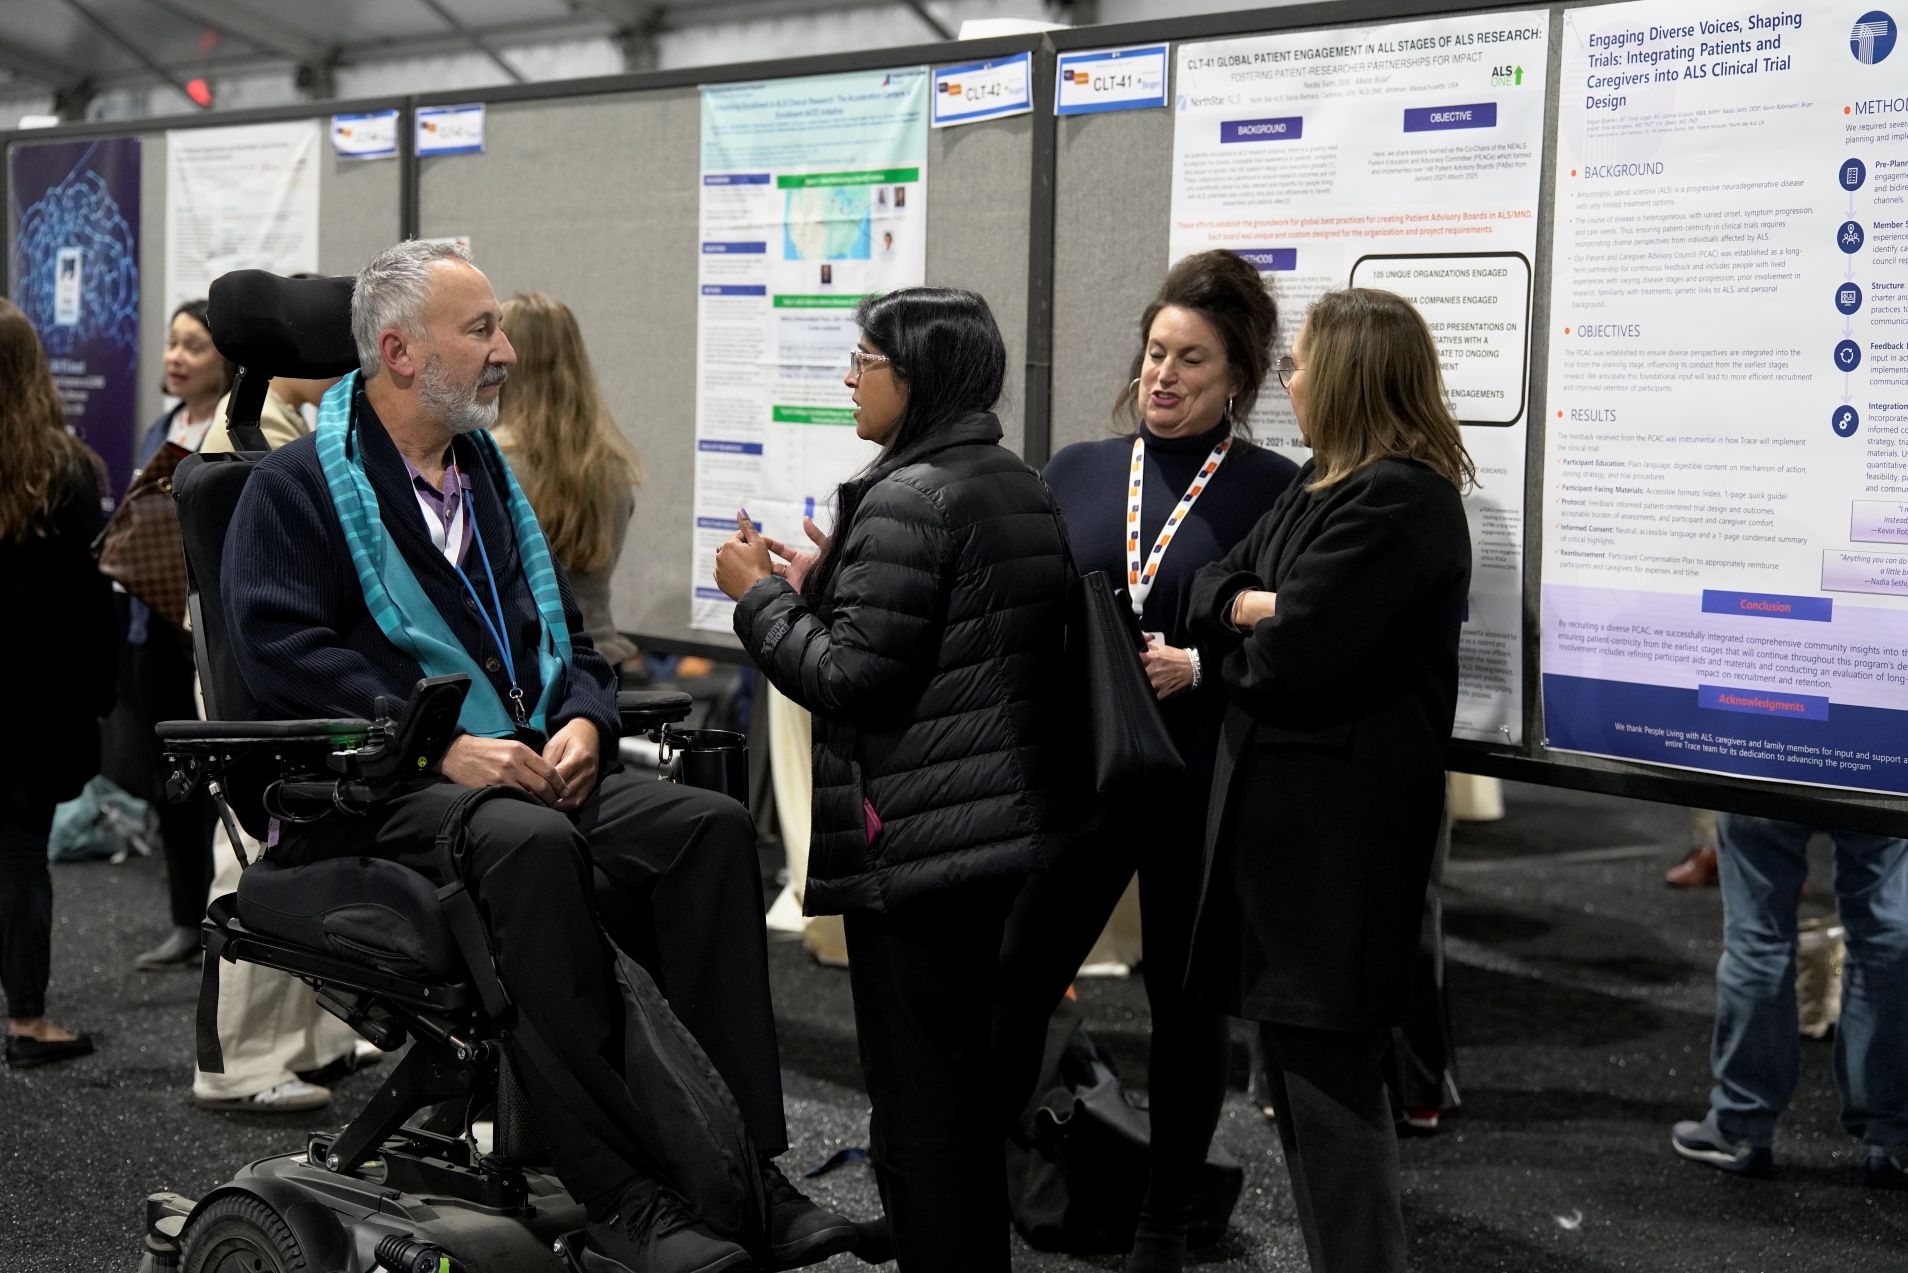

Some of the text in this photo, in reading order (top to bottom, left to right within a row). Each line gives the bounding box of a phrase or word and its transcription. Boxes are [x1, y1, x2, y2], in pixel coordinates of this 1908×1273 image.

[1589, 12, 1802, 50] Engaging Diverse Voices, Shaping
[1188, 28, 1541, 70] CLT-41 GLOBAL PATIENT ENGAGEMENT IN ALL STAGES OF ALS RESEARCH:
[1588, 34, 1780, 68] Trials: Integrating Patients and
[1230, 51, 1483, 82] FOSTERING PATIENT-RESEARCHER PARTNERSHIPS FOR IMPACT
[1492, 66, 1512, 77] ALS
[1587, 54, 1790, 90] Caregivers into ALS Clinical Trial
[1094, 75, 1131, 91] CLT-41
[1491, 77, 1512, 87] ONE
[966, 83, 1001, 101] CLT-42
[1586, 93, 1626, 111] Design
[1856, 98, 1908, 115] METHO
[1430, 111, 1472, 123] OBJECTIVE
[1238, 123, 1286, 135] BACKGROUND
[1859, 121, 1886, 132] required
[1846, 133, 1889, 145] planning and
[1584, 162, 1664, 179] BACKGROUND
[1431, 213, 1461, 222] Advisory
[1463, 212, 1488, 220] Boards
[1414, 269, 1470, 278] ORGANIZATIONS
[1472, 269, 1508, 277] ENGAGED
[1447, 323, 1504, 331] PRESENTATIONS
[1506, 323, 1517, 331] ON
[1578, 325, 1640, 338] OBJECTIVES
[1466, 350, 1499, 358] ONGOING
[1870, 354, 1888, 363] input
[1452, 390, 1504, 398] ENGAGEMENTS
[1571, 409, 1616, 422] RESULTS
[1266, 437, 1284, 447] 2021
[1866, 472, 1899, 482] feasibility,
[1740, 598, 1792, 612] Conclusion
[765, 618, 784, 643] BAUER
[771, 622, 790, 646] EDDIE
[1558, 619, 1566, 630] By
[1568, 622, 1598, 632] recruiting
[1607, 624, 1630, 633] diverse
[1666, 630, 1706, 641] successfully
[1708, 632, 1744, 644] integrated
[1746, 637, 1802, 648] comprehensive
[1804, 642, 1847, 654] community
[1850, 644, 1880, 655] insights
[1883, 646, 1898, 656] into
[1587, 635, 1895, 670] patient-centricity from the earliest stages that will continue throughout this program's
[1628, 649, 1652, 661] refining
[1655, 653, 1690, 663] participant
[1692, 656, 1706, 664] aids
[1708, 658, 1722, 666] and
[1724, 660, 1756, 669] materials
[1759, 662, 1773, 670] and
[1775, 664, 1818, 677] conducting
[1833, 669, 1873, 680] evaluation
[1696, 667, 1719, 678] impact
[1734, 673, 1776, 683] recruitment
[1778, 676, 1792, 685] and
[1719, 694, 1805, 712] Acknowledgments
[1614, 722, 1625, 731] We
[1626, 724, 1642, 732] thank
[1644, 726, 1664, 736] People
[1666, 729, 1684, 740] Living
[1701, 733, 1713, 742] ALS,
[1715, 737, 1746, 746] caregivers
[1764, 740, 1784, 751] family
[1787, 745, 1819, 754] members
[1822, 747, 1832, 755] for
[1835, 748, 1853, 758] input
[1872, 755, 1900, 763] support
[1665, 740, 1682, 748] entire
[1684, 742, 1701, 750] Trace
[1719, 746, 1728, 754] for
[1739, 749, 1775, 760] dedication
[1787, 754, 1823, 767] advancing
[1826, 758, 1838, 767] the
[1840, 762, 1871, 770] program
